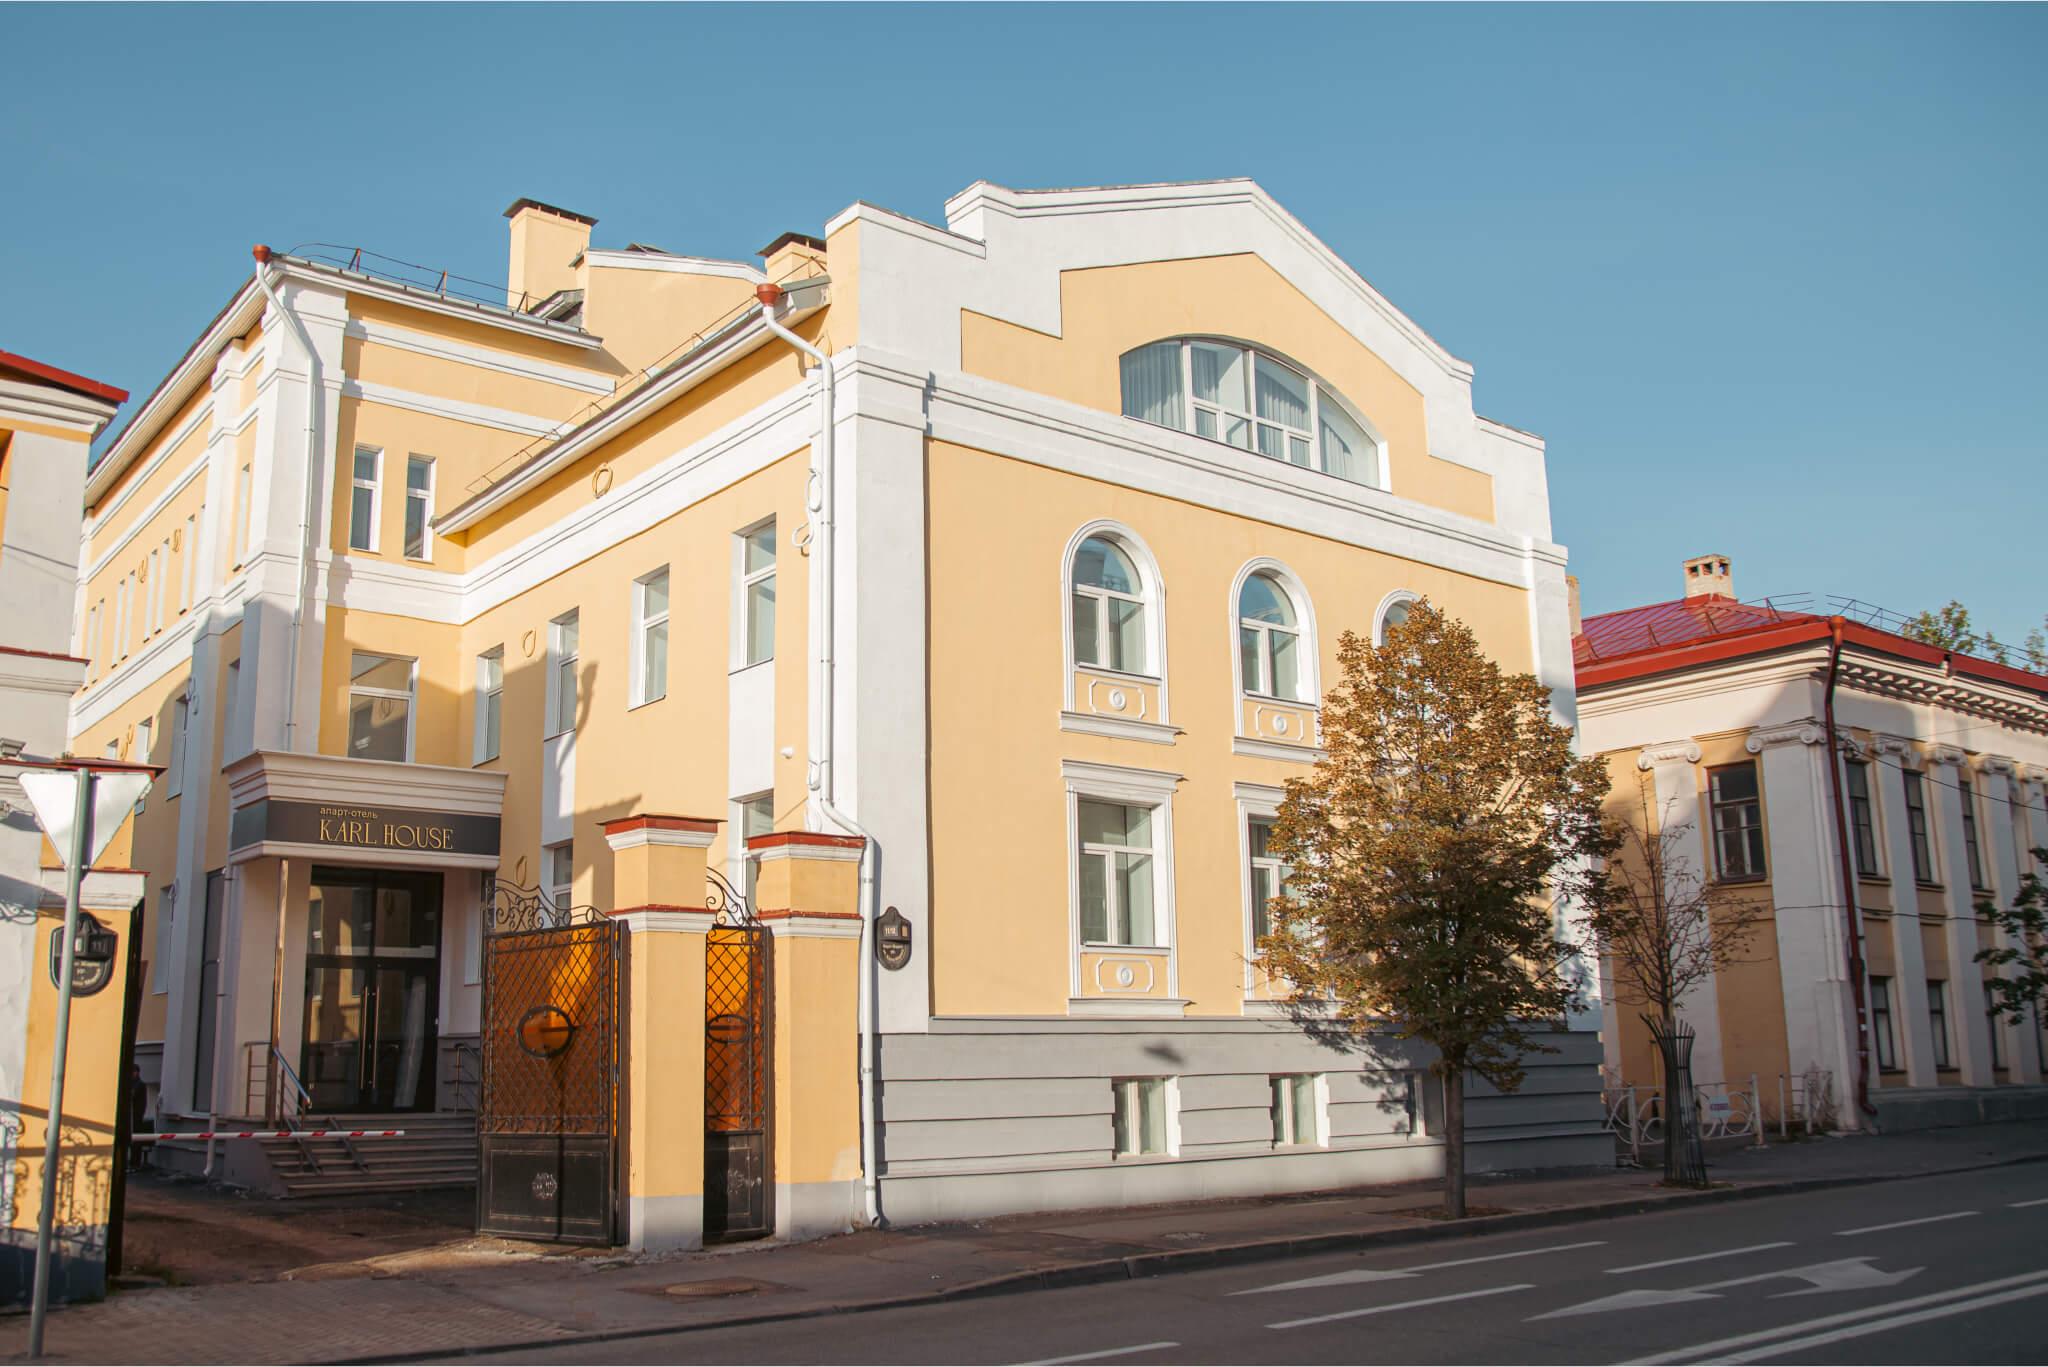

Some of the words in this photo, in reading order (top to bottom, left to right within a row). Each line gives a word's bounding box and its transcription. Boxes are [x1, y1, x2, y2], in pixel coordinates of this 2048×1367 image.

[320, 807, 378, 819] апарт-отель
[320, 819, 377, 845] KARL
[384, 824, 454, 850] HOUSE
